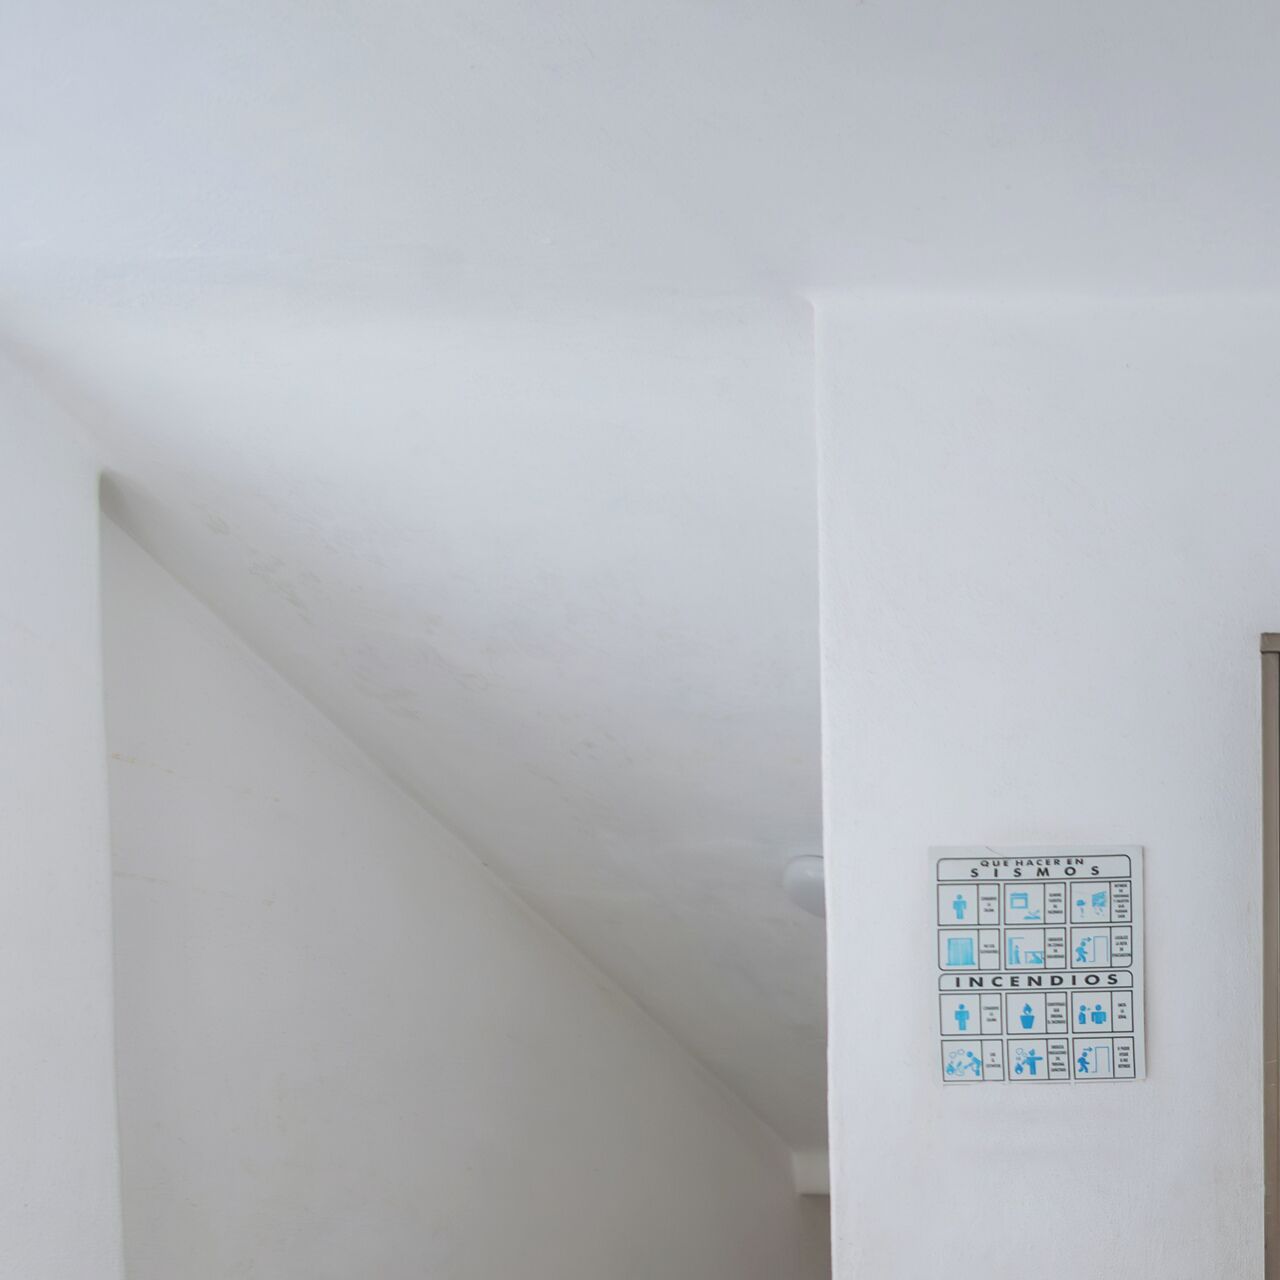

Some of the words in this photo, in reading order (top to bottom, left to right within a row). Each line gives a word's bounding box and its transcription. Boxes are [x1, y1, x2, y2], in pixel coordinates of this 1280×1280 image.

[1066, 858, 1084, 866] EN
[970, 866, 1100, 878] SISMOS
[955, 974, 1119, 988] INCENDIOS
